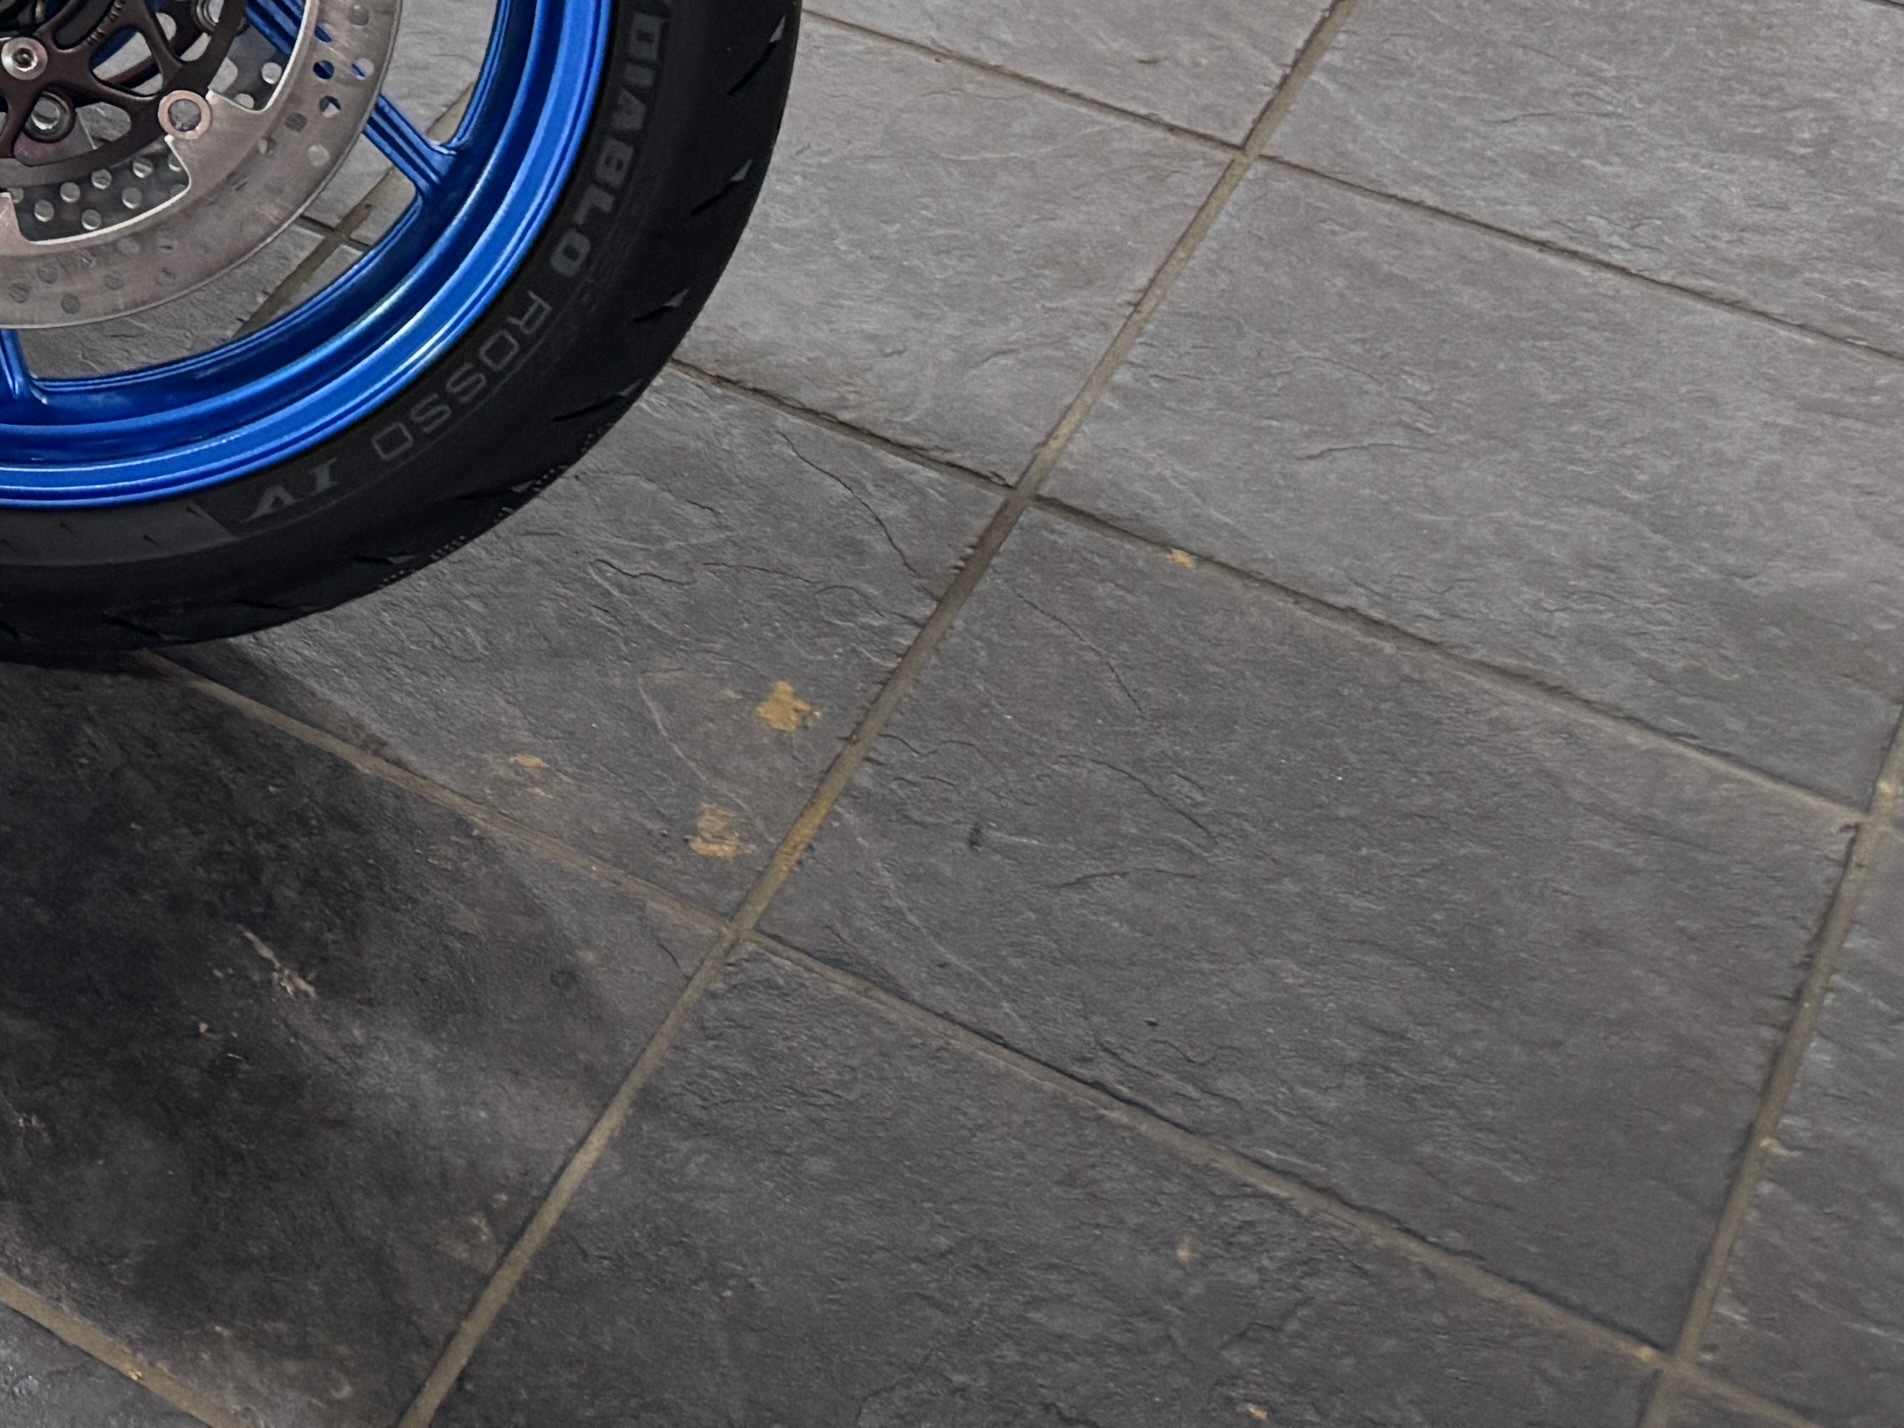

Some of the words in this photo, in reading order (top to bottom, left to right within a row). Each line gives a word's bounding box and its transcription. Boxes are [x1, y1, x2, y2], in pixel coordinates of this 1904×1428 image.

[550, 14, 668, 278] DIABLO
[370, 288, 554, 464] ROSSO
[250, 457, 340, 518] IV
